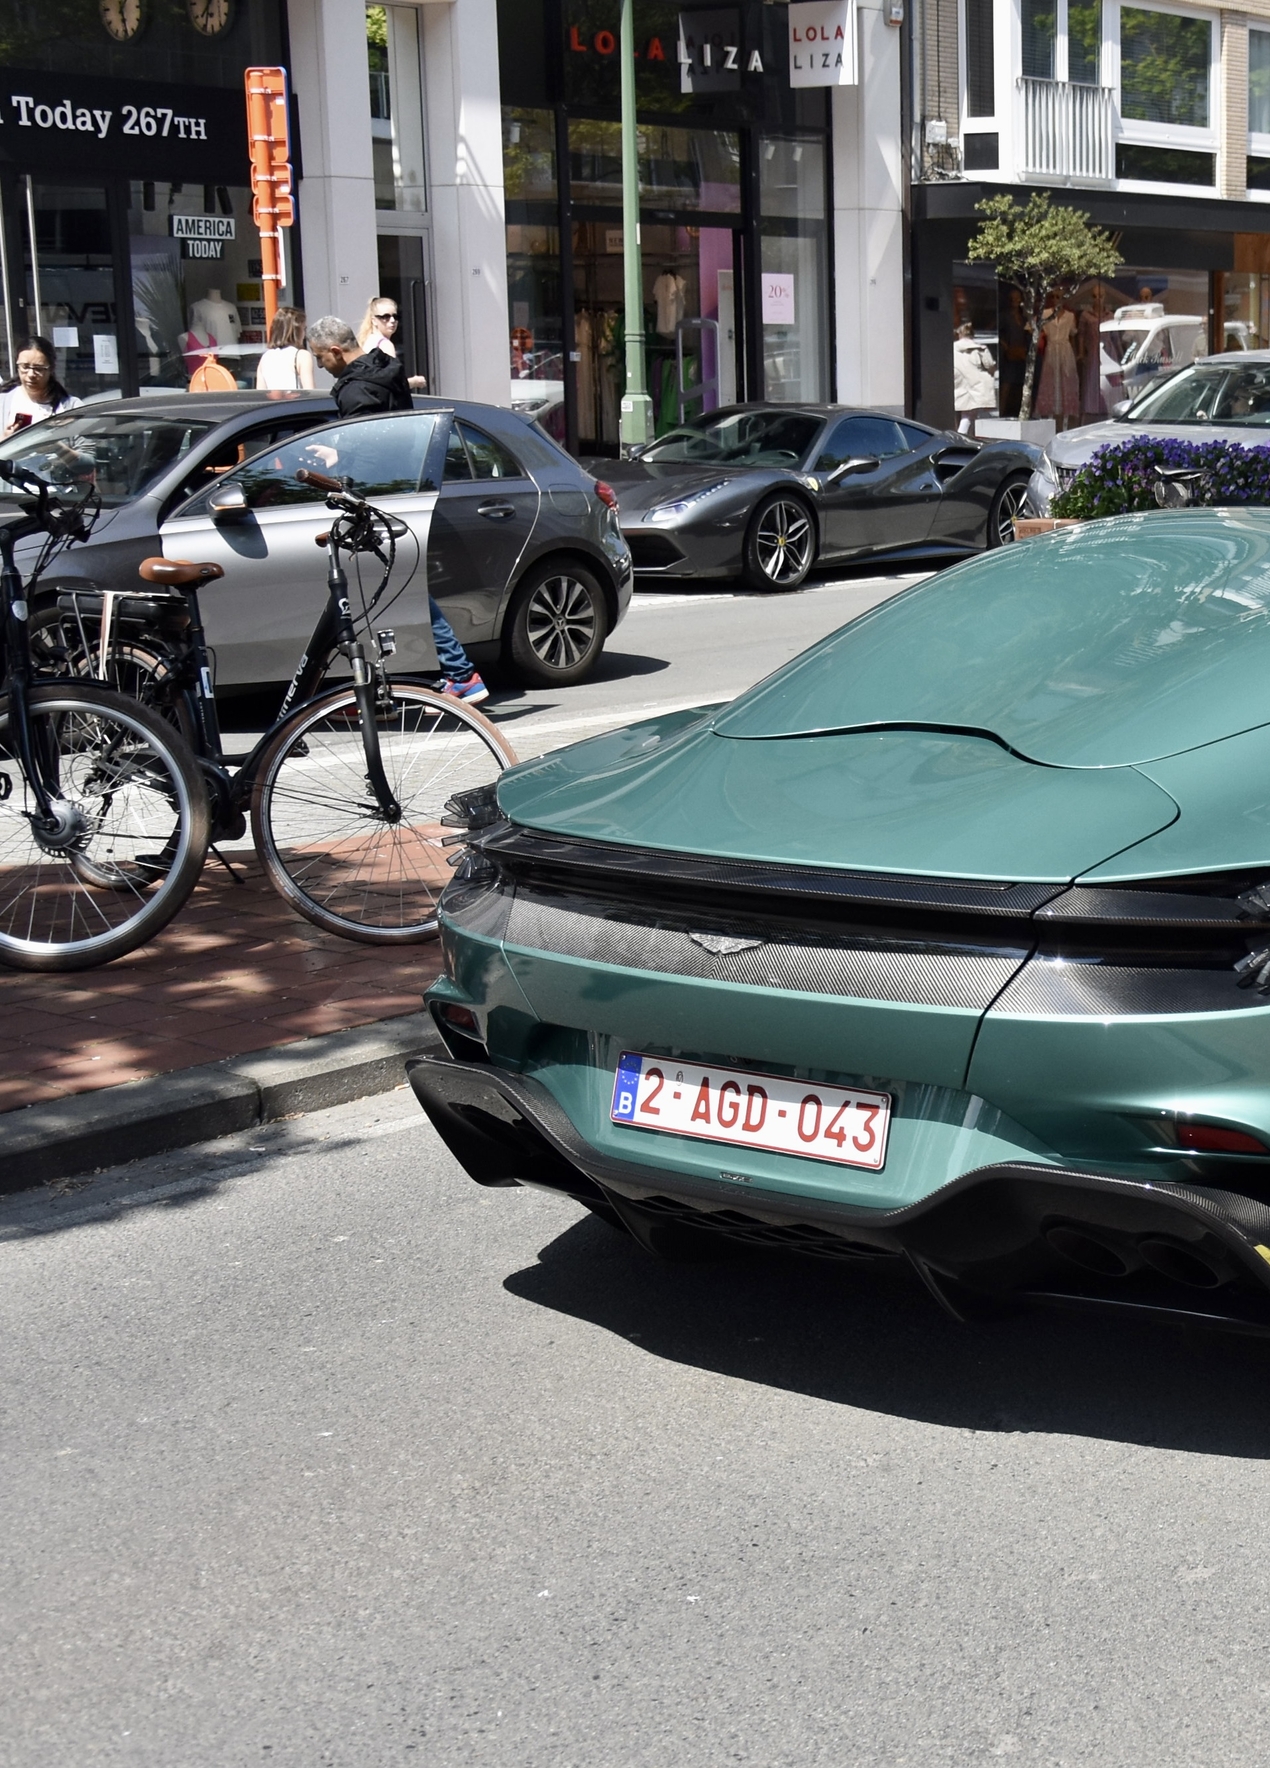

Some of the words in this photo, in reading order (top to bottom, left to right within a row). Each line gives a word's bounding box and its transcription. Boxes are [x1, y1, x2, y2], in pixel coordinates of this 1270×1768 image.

[793, 25, 845, 42] LOLA
[570, 26, 665, 60] LOA
[677, 40, 764, 72] LIZA
[793, 53, 844, 69] LIZA
[11, 95, 112, 138] Today
[121, 105, 207, 139] 267TH
[175, 218, 233, 237] AMERICA
[187, 240, 222, 258] TODAY
[618, 1092, 633, 1113] B
